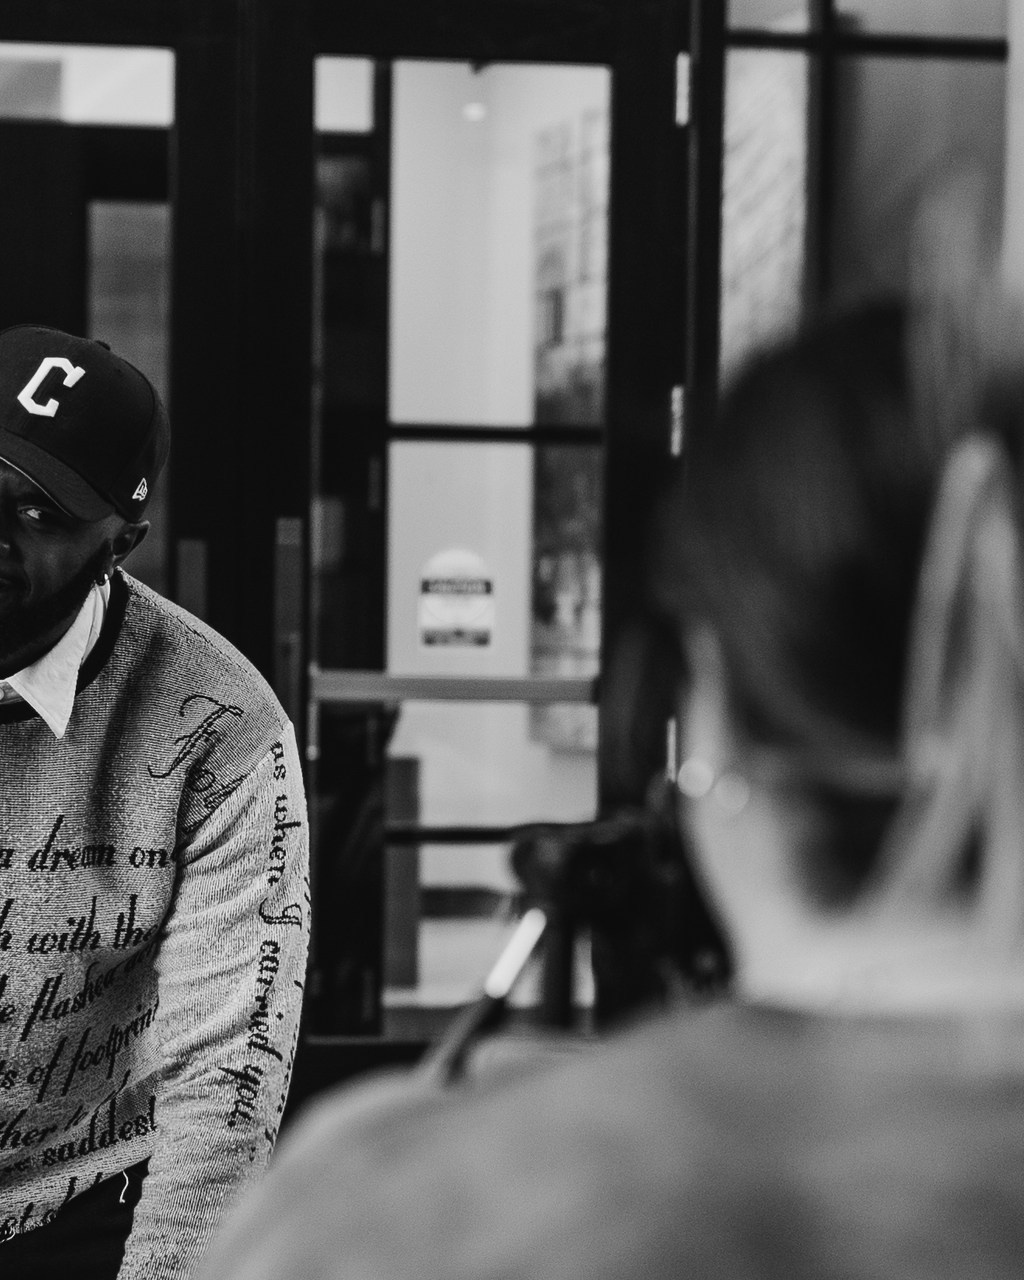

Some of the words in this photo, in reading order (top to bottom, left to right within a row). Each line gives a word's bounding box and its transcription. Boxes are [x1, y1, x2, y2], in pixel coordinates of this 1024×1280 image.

[17, 357, 86, 417] C
[27, 814, 116, 872] dream
[267, 794, 302, 887] when
[28, 896, 101, 954] with
[112, 894, 158, 949] the
[20, 961, 123, 1042] flashed
[248, 939, 284, 1062] carried
[26, 1036, 68, 1103] of
